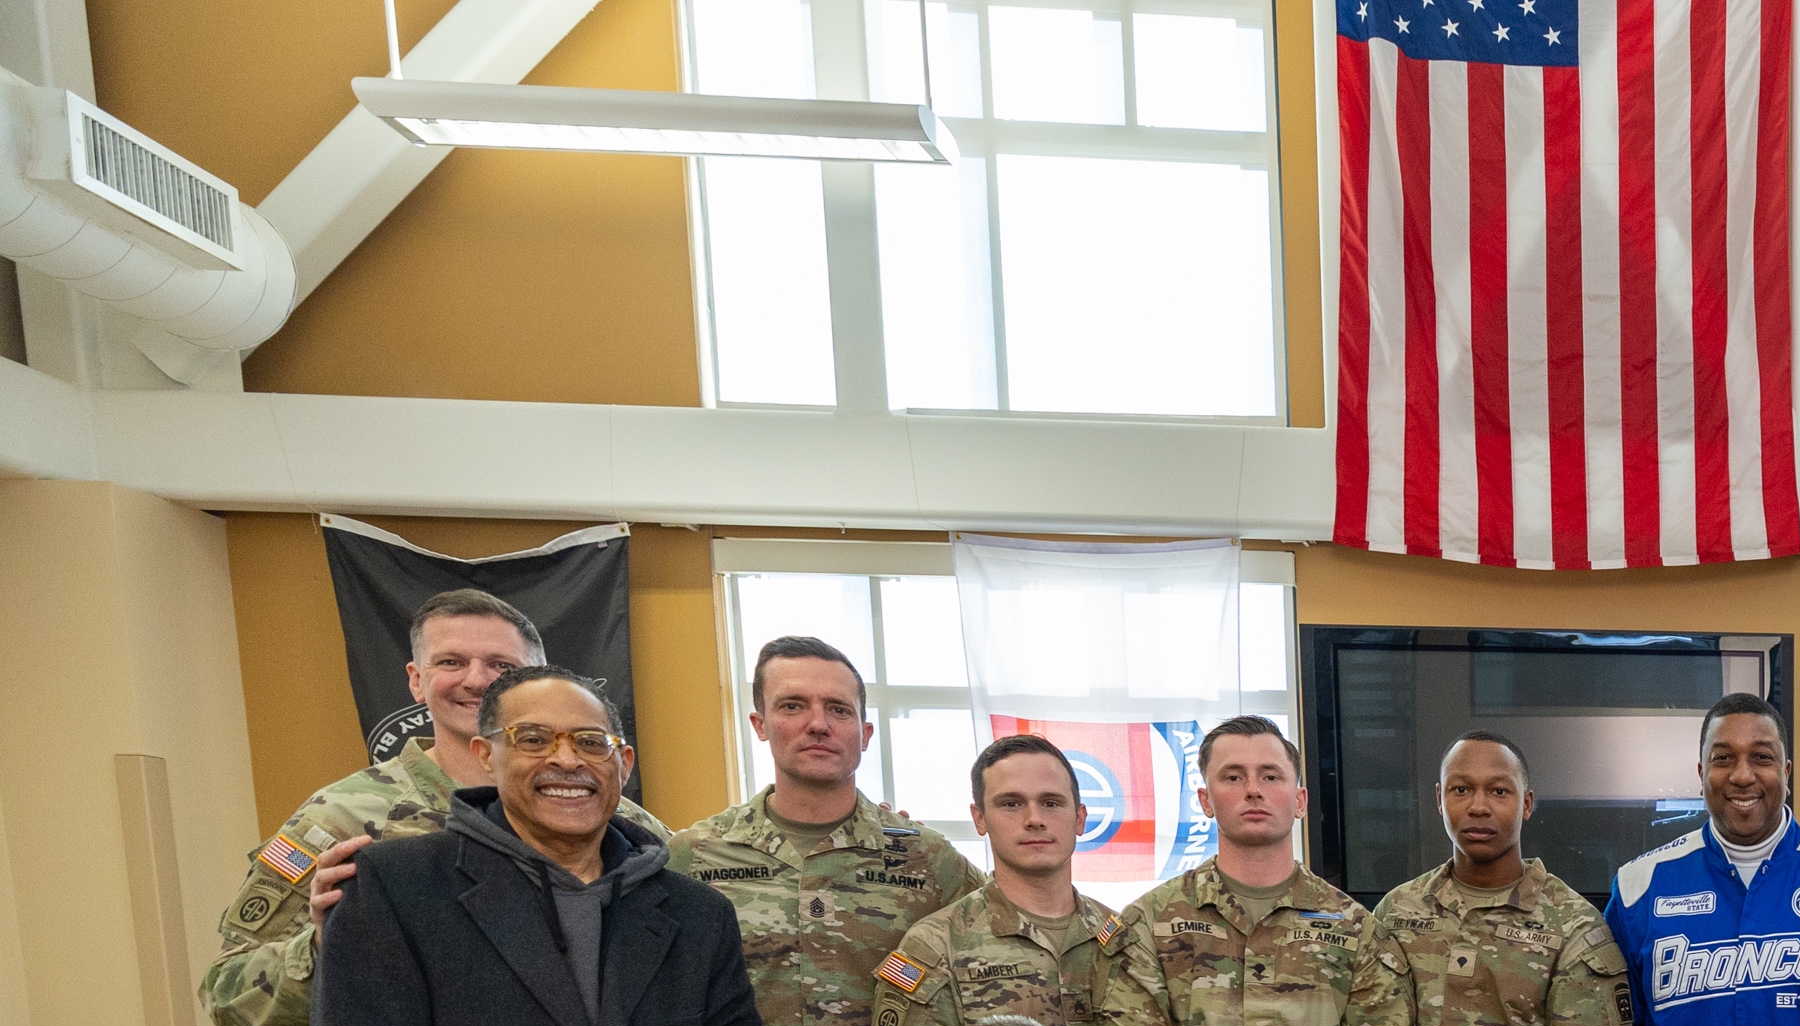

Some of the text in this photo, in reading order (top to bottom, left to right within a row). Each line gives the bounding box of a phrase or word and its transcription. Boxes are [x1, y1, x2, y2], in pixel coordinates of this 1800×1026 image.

[700, 867, 769, 882] WAGGONER
[1661, 895, 1711, 909] Fayetteville
[1171, 922, 1212, 934] LEMIRE
[1393, 919, 1435, 930] HEYWARD
[1294, 930, 1348, 947] U.S. ARMY
[1524, 931, 1552, 945] ARMY
[968, 964, 1020, 980] LAMBERT
[1776, 996, 1797, 1005] EST
